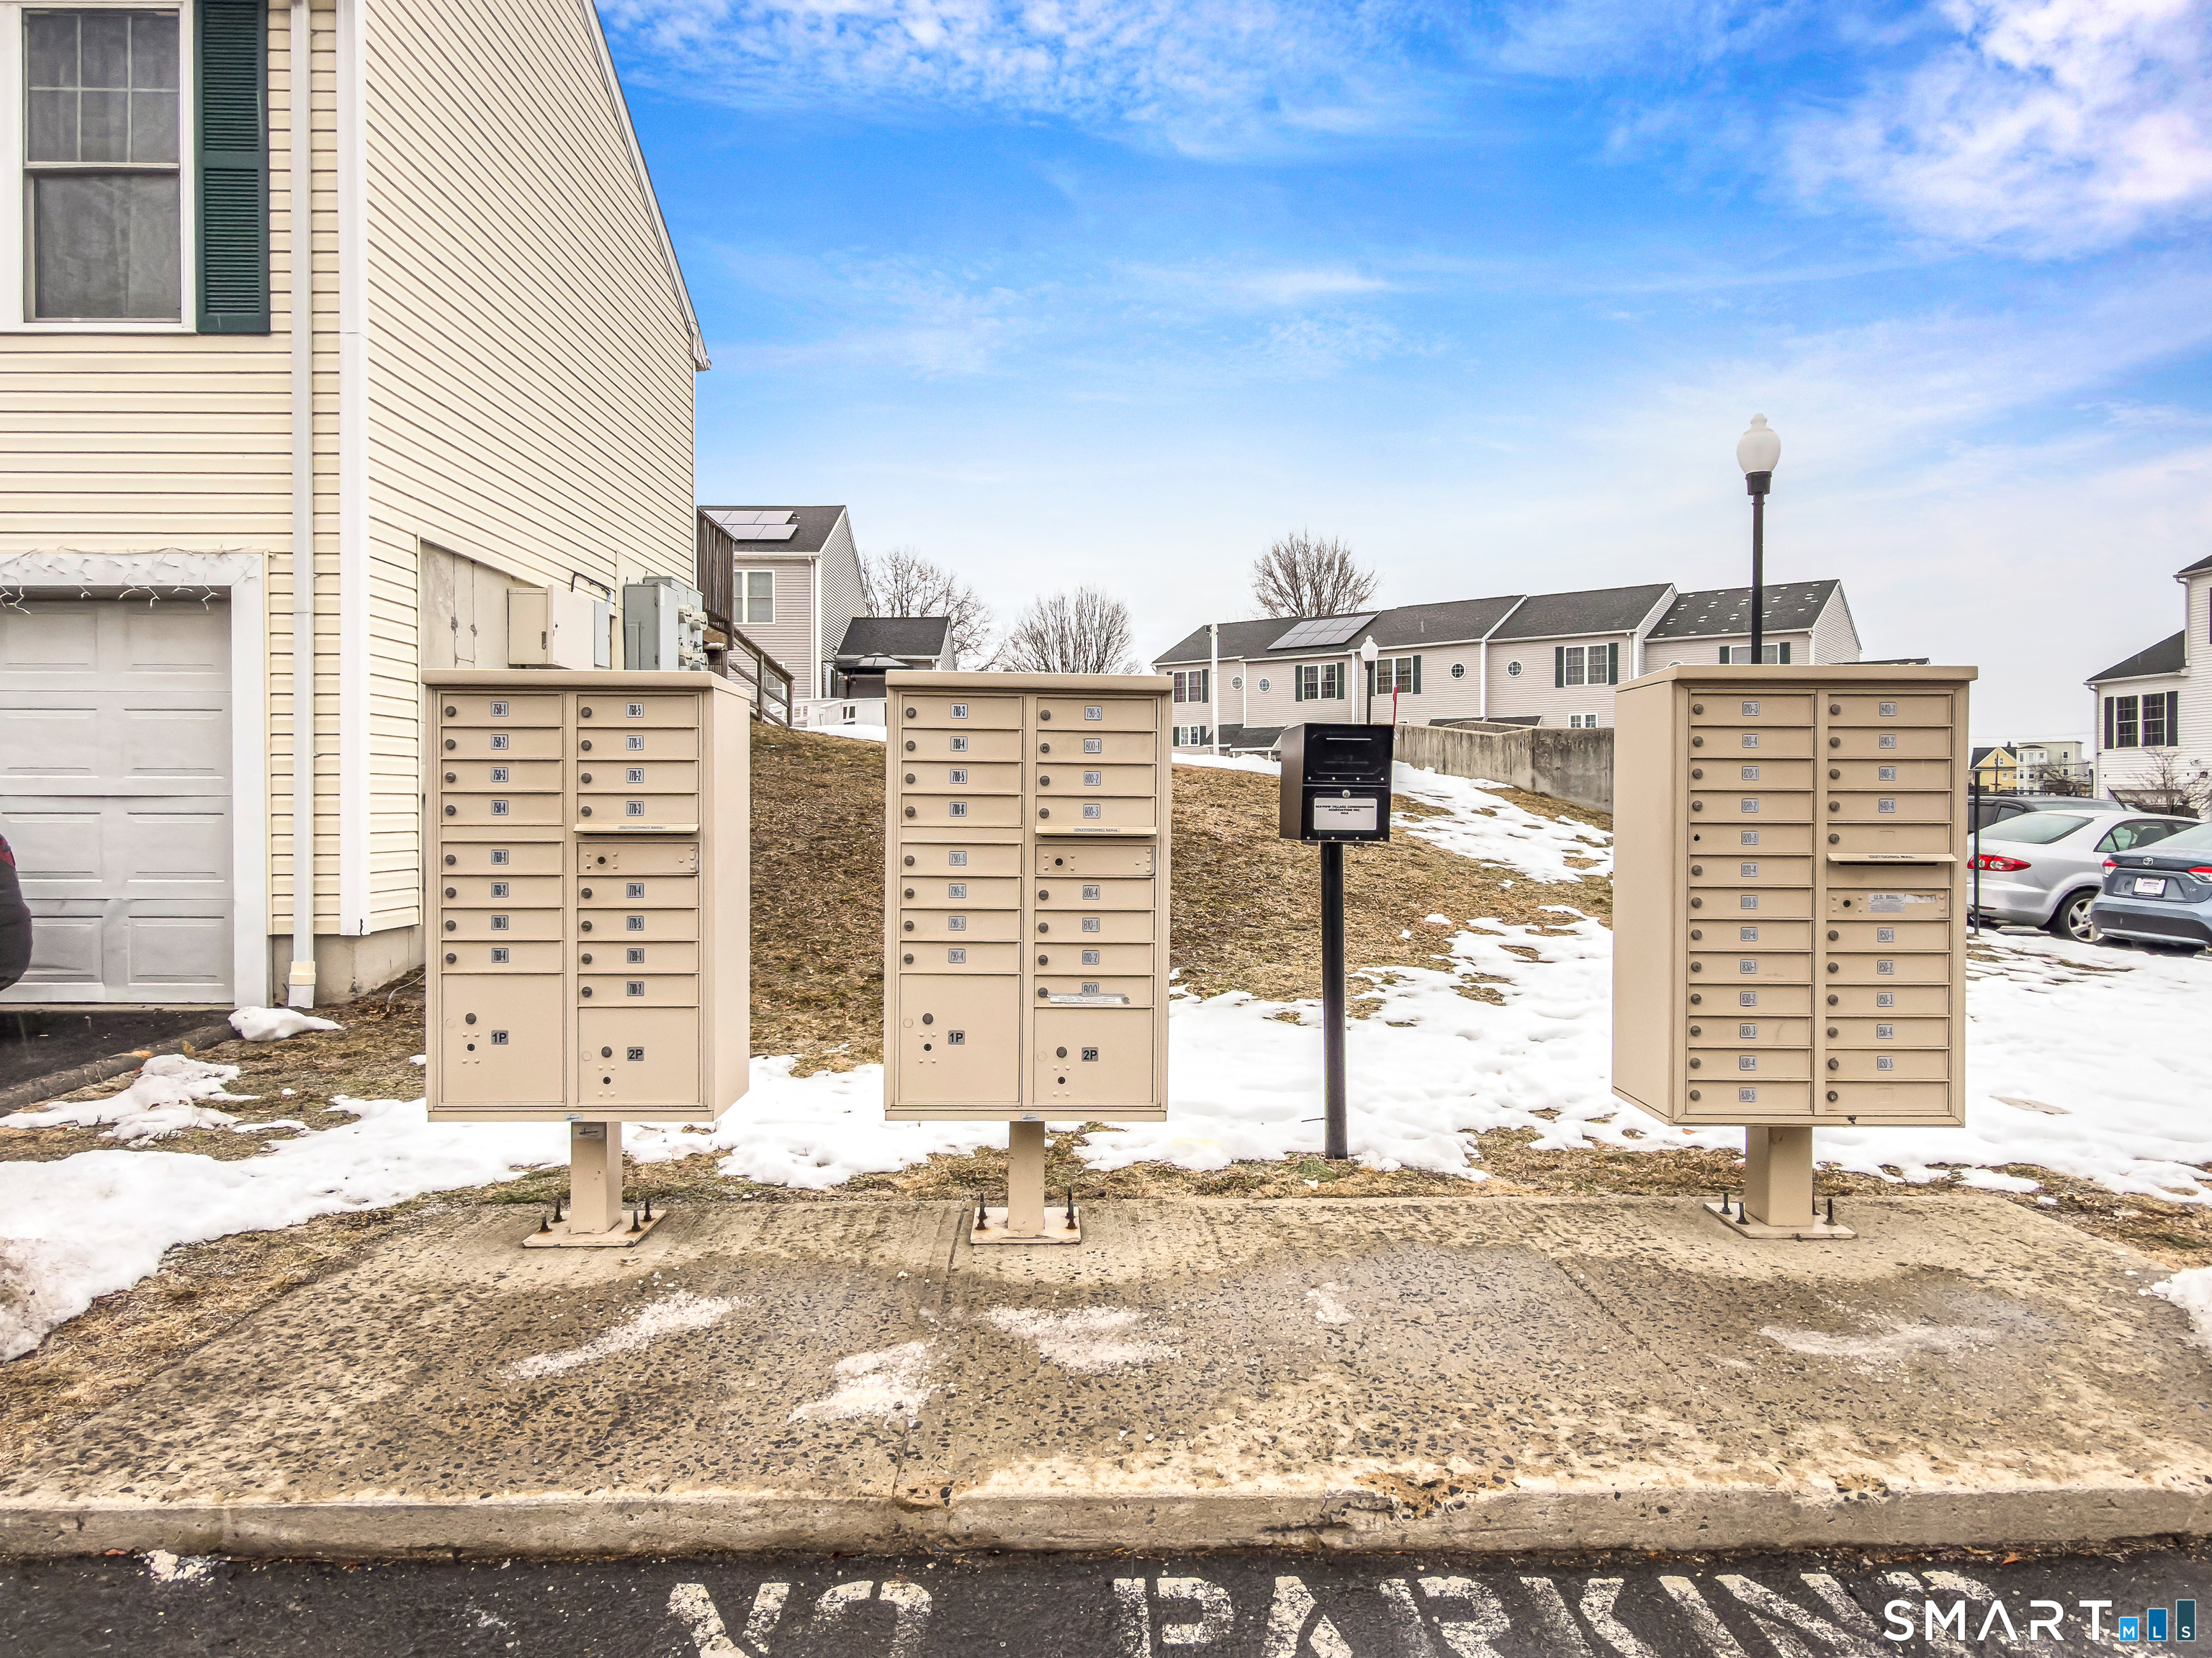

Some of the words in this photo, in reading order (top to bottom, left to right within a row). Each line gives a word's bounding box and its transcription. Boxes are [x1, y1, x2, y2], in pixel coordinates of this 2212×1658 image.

[629, 737, 642, 749] 770-1
[1085, 740, 1100, 752] 800-1
[629, 770, 642, 782] 770-2
[1085, 773, 1100, 784] 800-2
[629, 803, 642, 814] 770-3
[1084, 806, 1099, 817] 800-3
[950, 853, 966, 864] 790-1
[1084, 887, 1098, 898] 800-4
[629, 917, 642, 929] 770-5
[1084, 919, 1098, 930] 810-1
[492, 1032, 507, 1043] 1P
[949, 1032, 963, 1043] 1P
[628, 1049, 643, 1060] 2P
[1082, 1050, 1097, 1060] 2P
